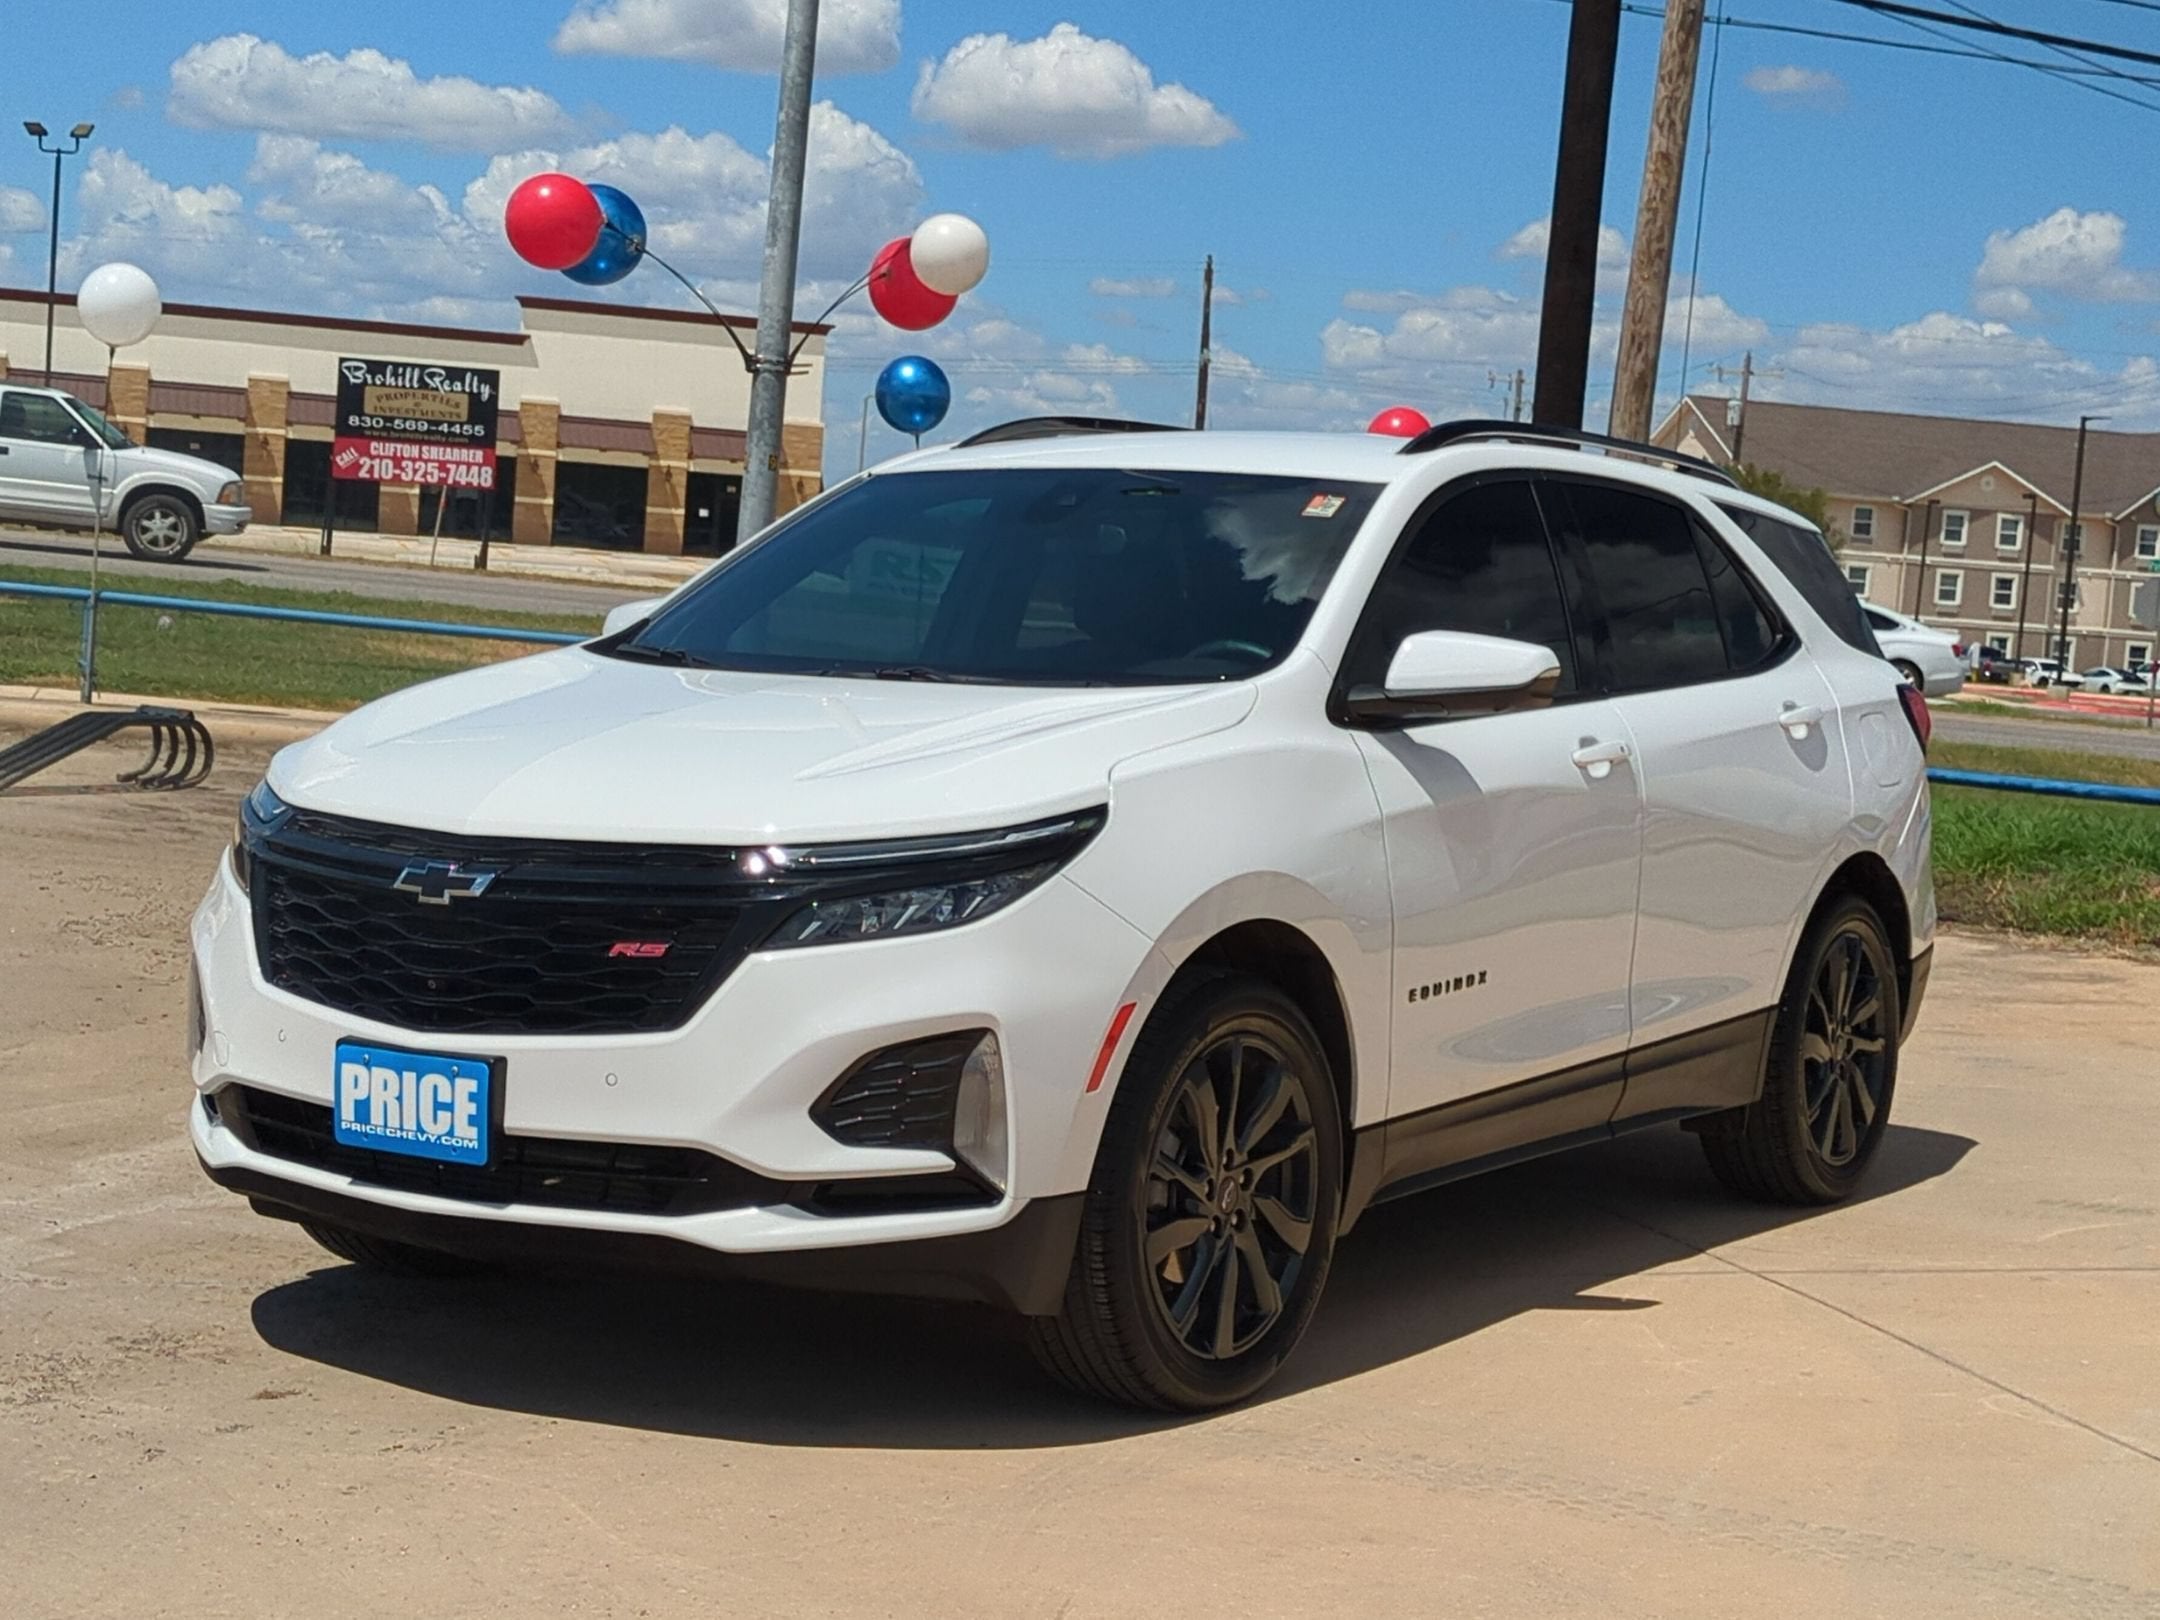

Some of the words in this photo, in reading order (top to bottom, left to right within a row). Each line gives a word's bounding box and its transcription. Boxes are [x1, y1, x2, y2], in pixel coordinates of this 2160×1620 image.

[423, 367, 490, 403] Realty
[373, 405, 462, 419] INVESTMENTS
[348, 415, 486, 437] 830-569-4455
[335, 446, 360, 467] CALL
[369, 441, 420, 460] CLIFTON
[358, 457, 493, 488] 210-325-7448
[608, 942, 669, 957] RS
[1407, 969, 1488, 1004] EQUINOX
[341, 1062, 479, 1140] PRICE
[341, 1121, 479, 1150] PRICECHEVY.COM
